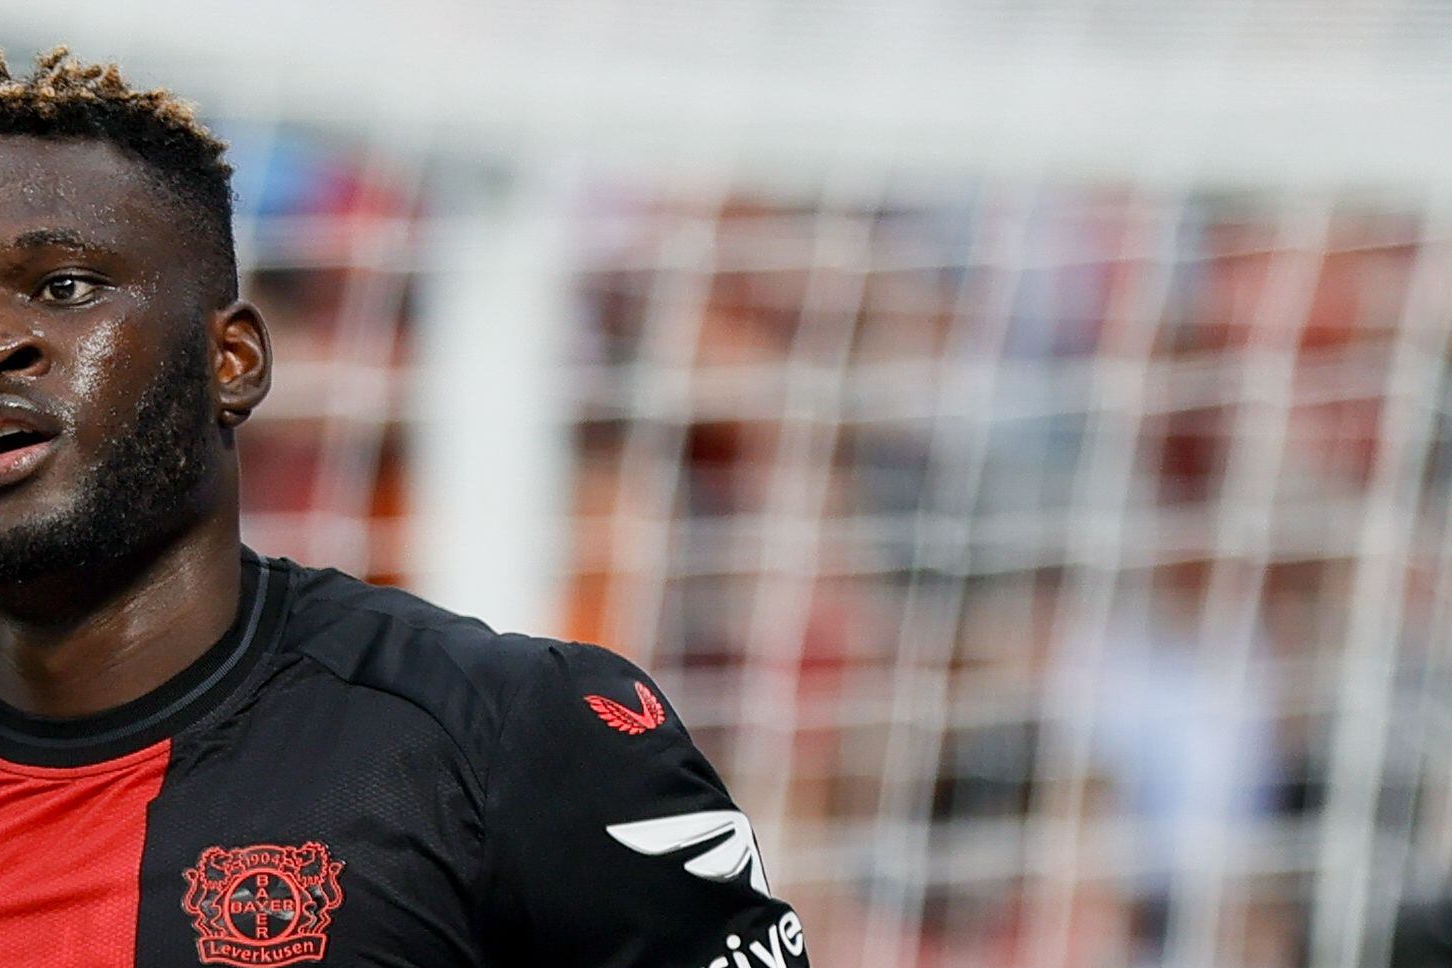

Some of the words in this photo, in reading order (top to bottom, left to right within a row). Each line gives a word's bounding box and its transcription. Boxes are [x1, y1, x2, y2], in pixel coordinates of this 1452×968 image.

[230, 899, 296, 914] BAYER
[256, 874, 269, 939] BAYER
[210, 941, 314, 963] Leverkusen
